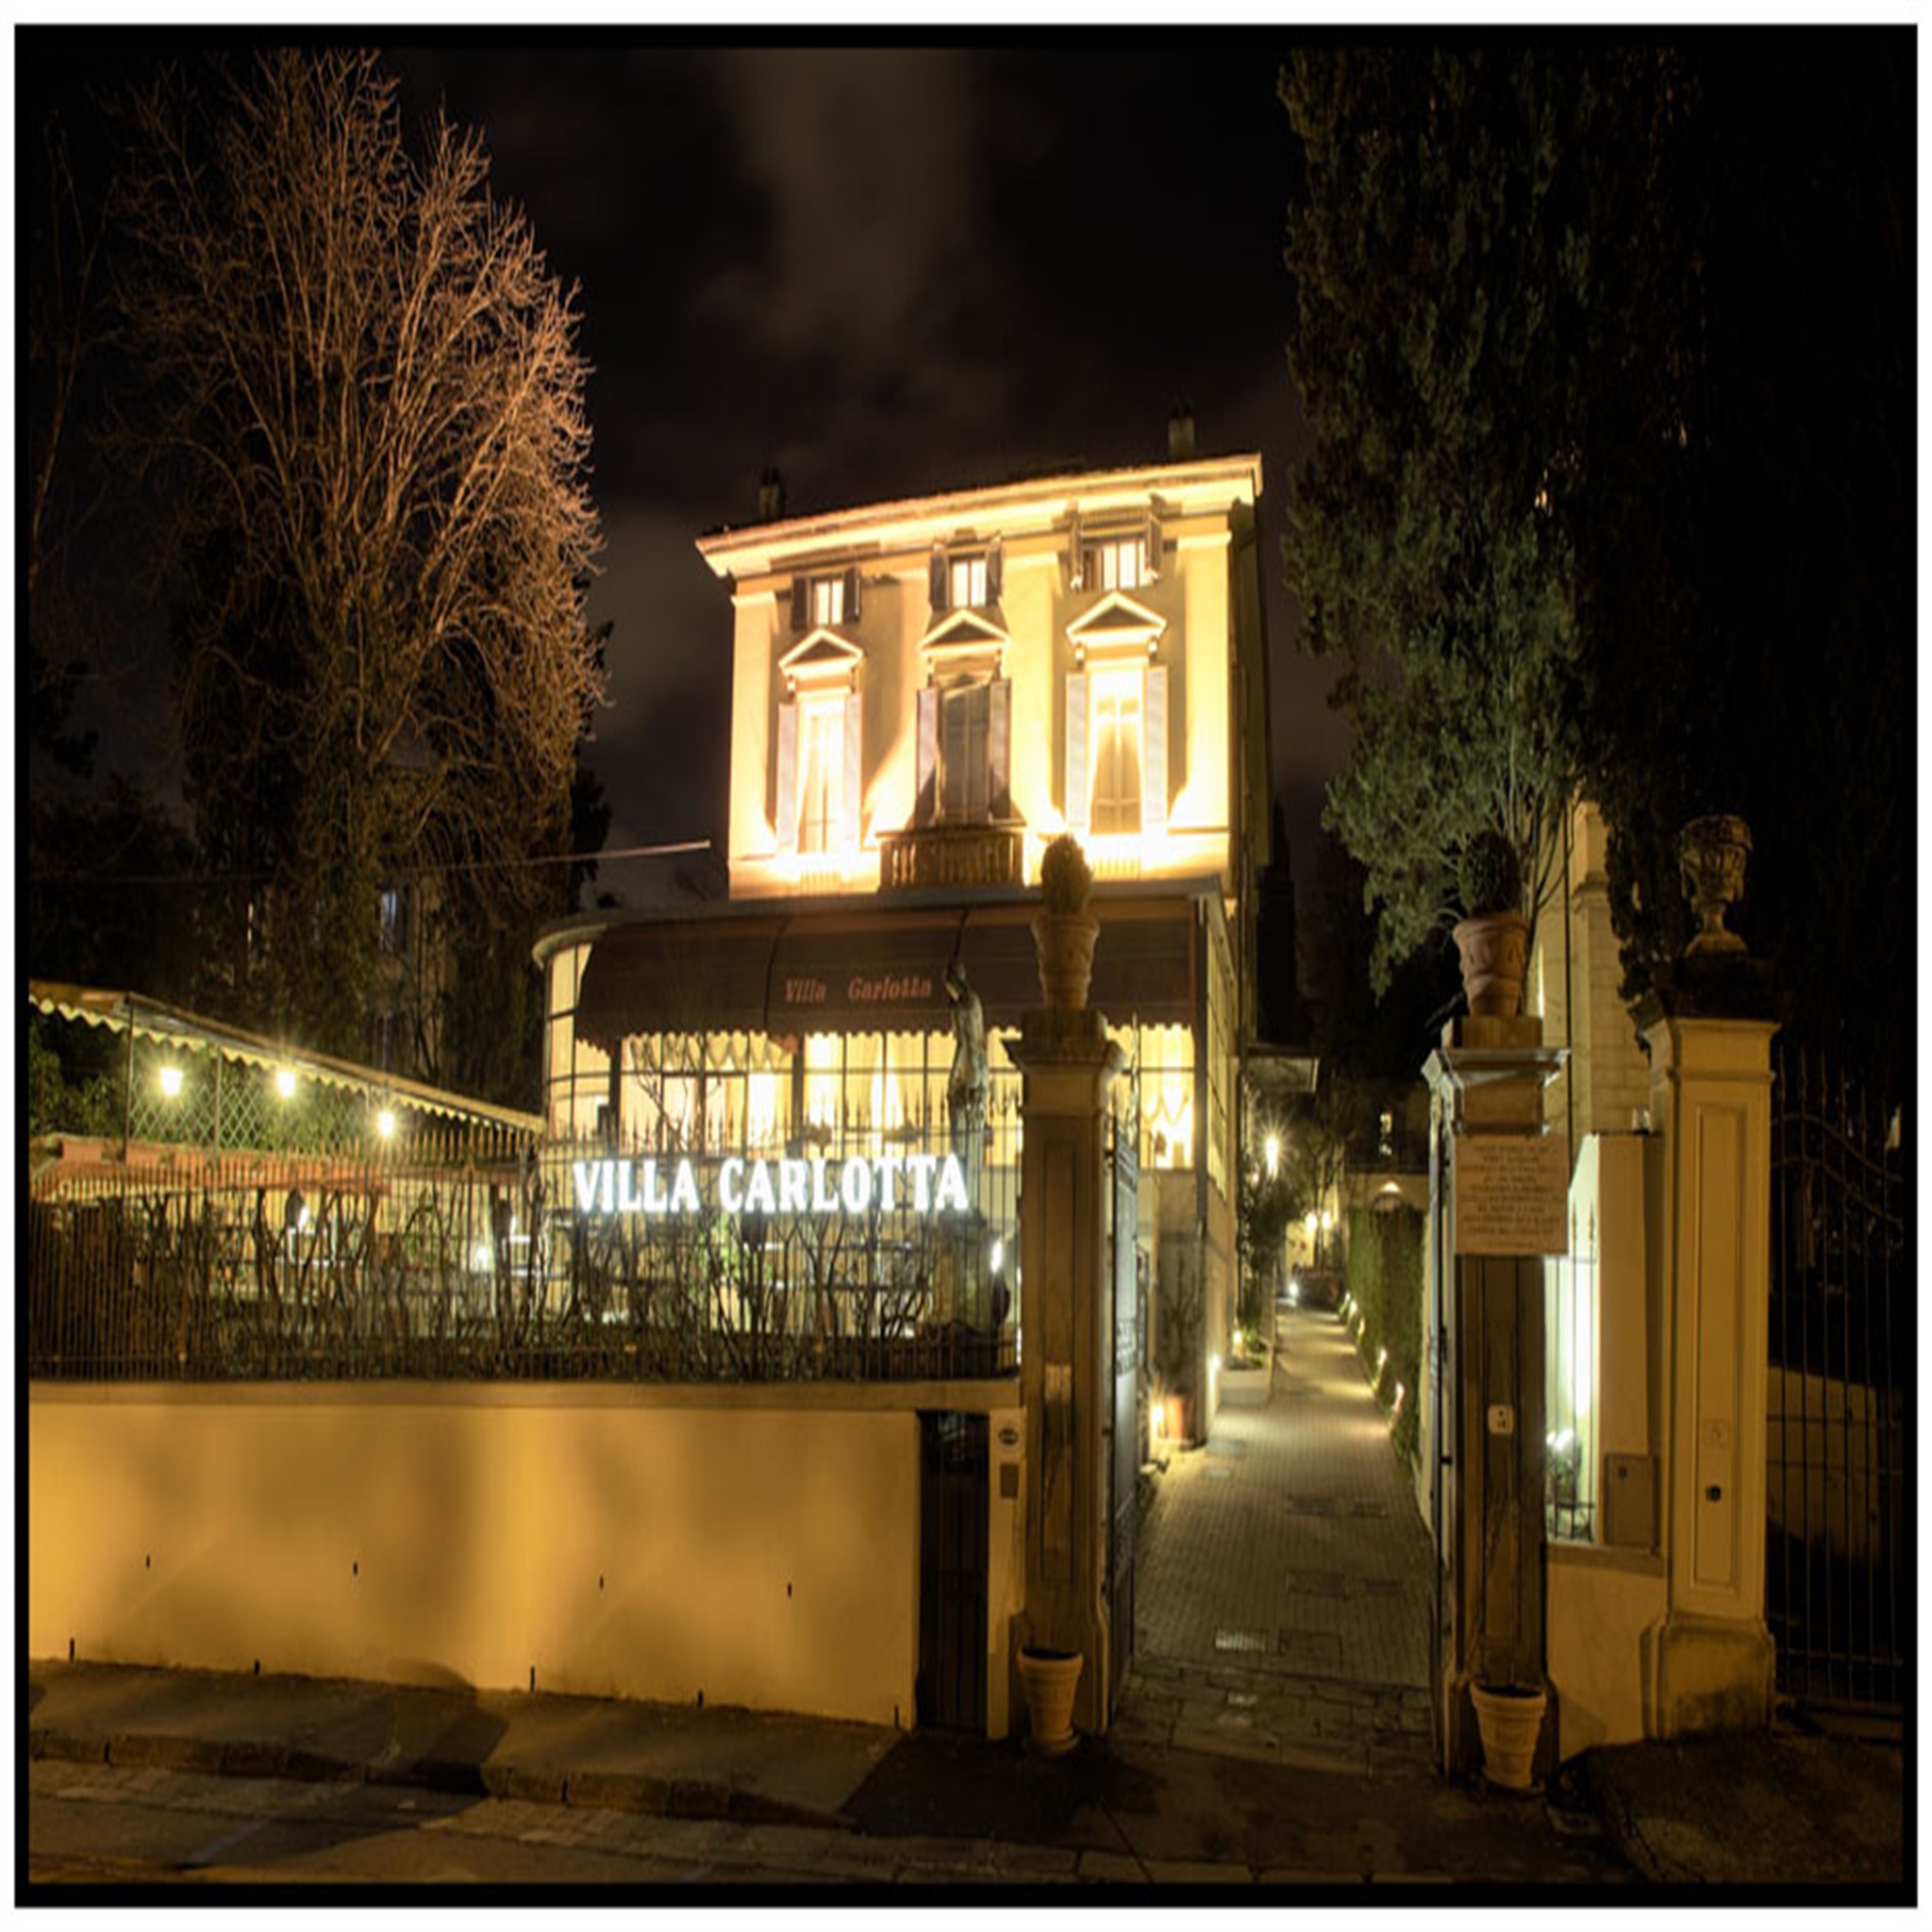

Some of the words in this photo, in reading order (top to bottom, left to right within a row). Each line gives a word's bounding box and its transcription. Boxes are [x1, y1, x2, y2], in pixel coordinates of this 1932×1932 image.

[785, 978, 827, 1002] Villa
[574, 1159, 701, 1213] VILLA
[719, 1153, 970, 1213] CARLOTTA
